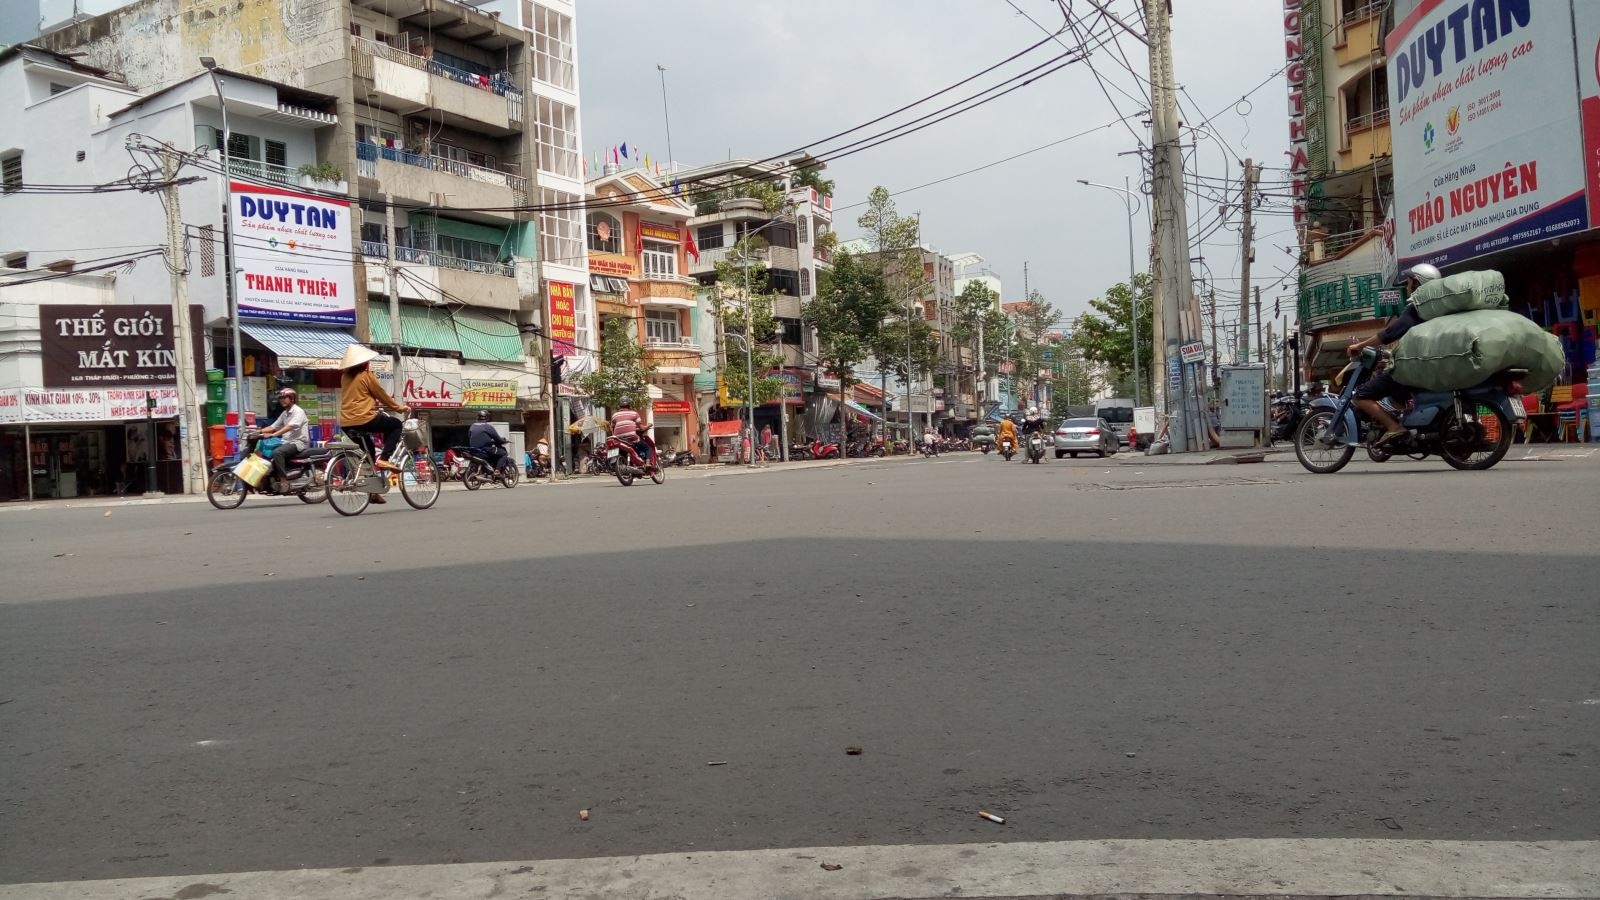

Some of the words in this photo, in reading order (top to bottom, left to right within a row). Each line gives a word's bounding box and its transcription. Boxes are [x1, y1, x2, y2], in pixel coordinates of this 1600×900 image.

[1456, 62, 1476, 90] chất
[1478, 51, 1509, 76] lượng
[1512, 40, 1534, 59] cao
[1444, 170, 1459, 184] Hàng
[1408, 191, 1445, 235] THẢO
[1449, 161, 1538, 218] NGUYÊN
[240, 195, 336, 230] DUYTAN
[1472, 218, 1488, 230] HÀNG
[1506, 208, 1518, 218] GIA
[1520, 201, 1540, 214] DỤNG
[245, 274, 293, 293] THANH
[297, 277, 337, 300] THIỆN
[56, 308, 106, 336] THẾ
[114, 310, 164, 336] GIỚI
[552, 314, 561, 325] CHO
[78, 339, 129, 368] MẮT
[136, 343, 176, 368] KÍN
[376, 371, 394, 380] Salon
